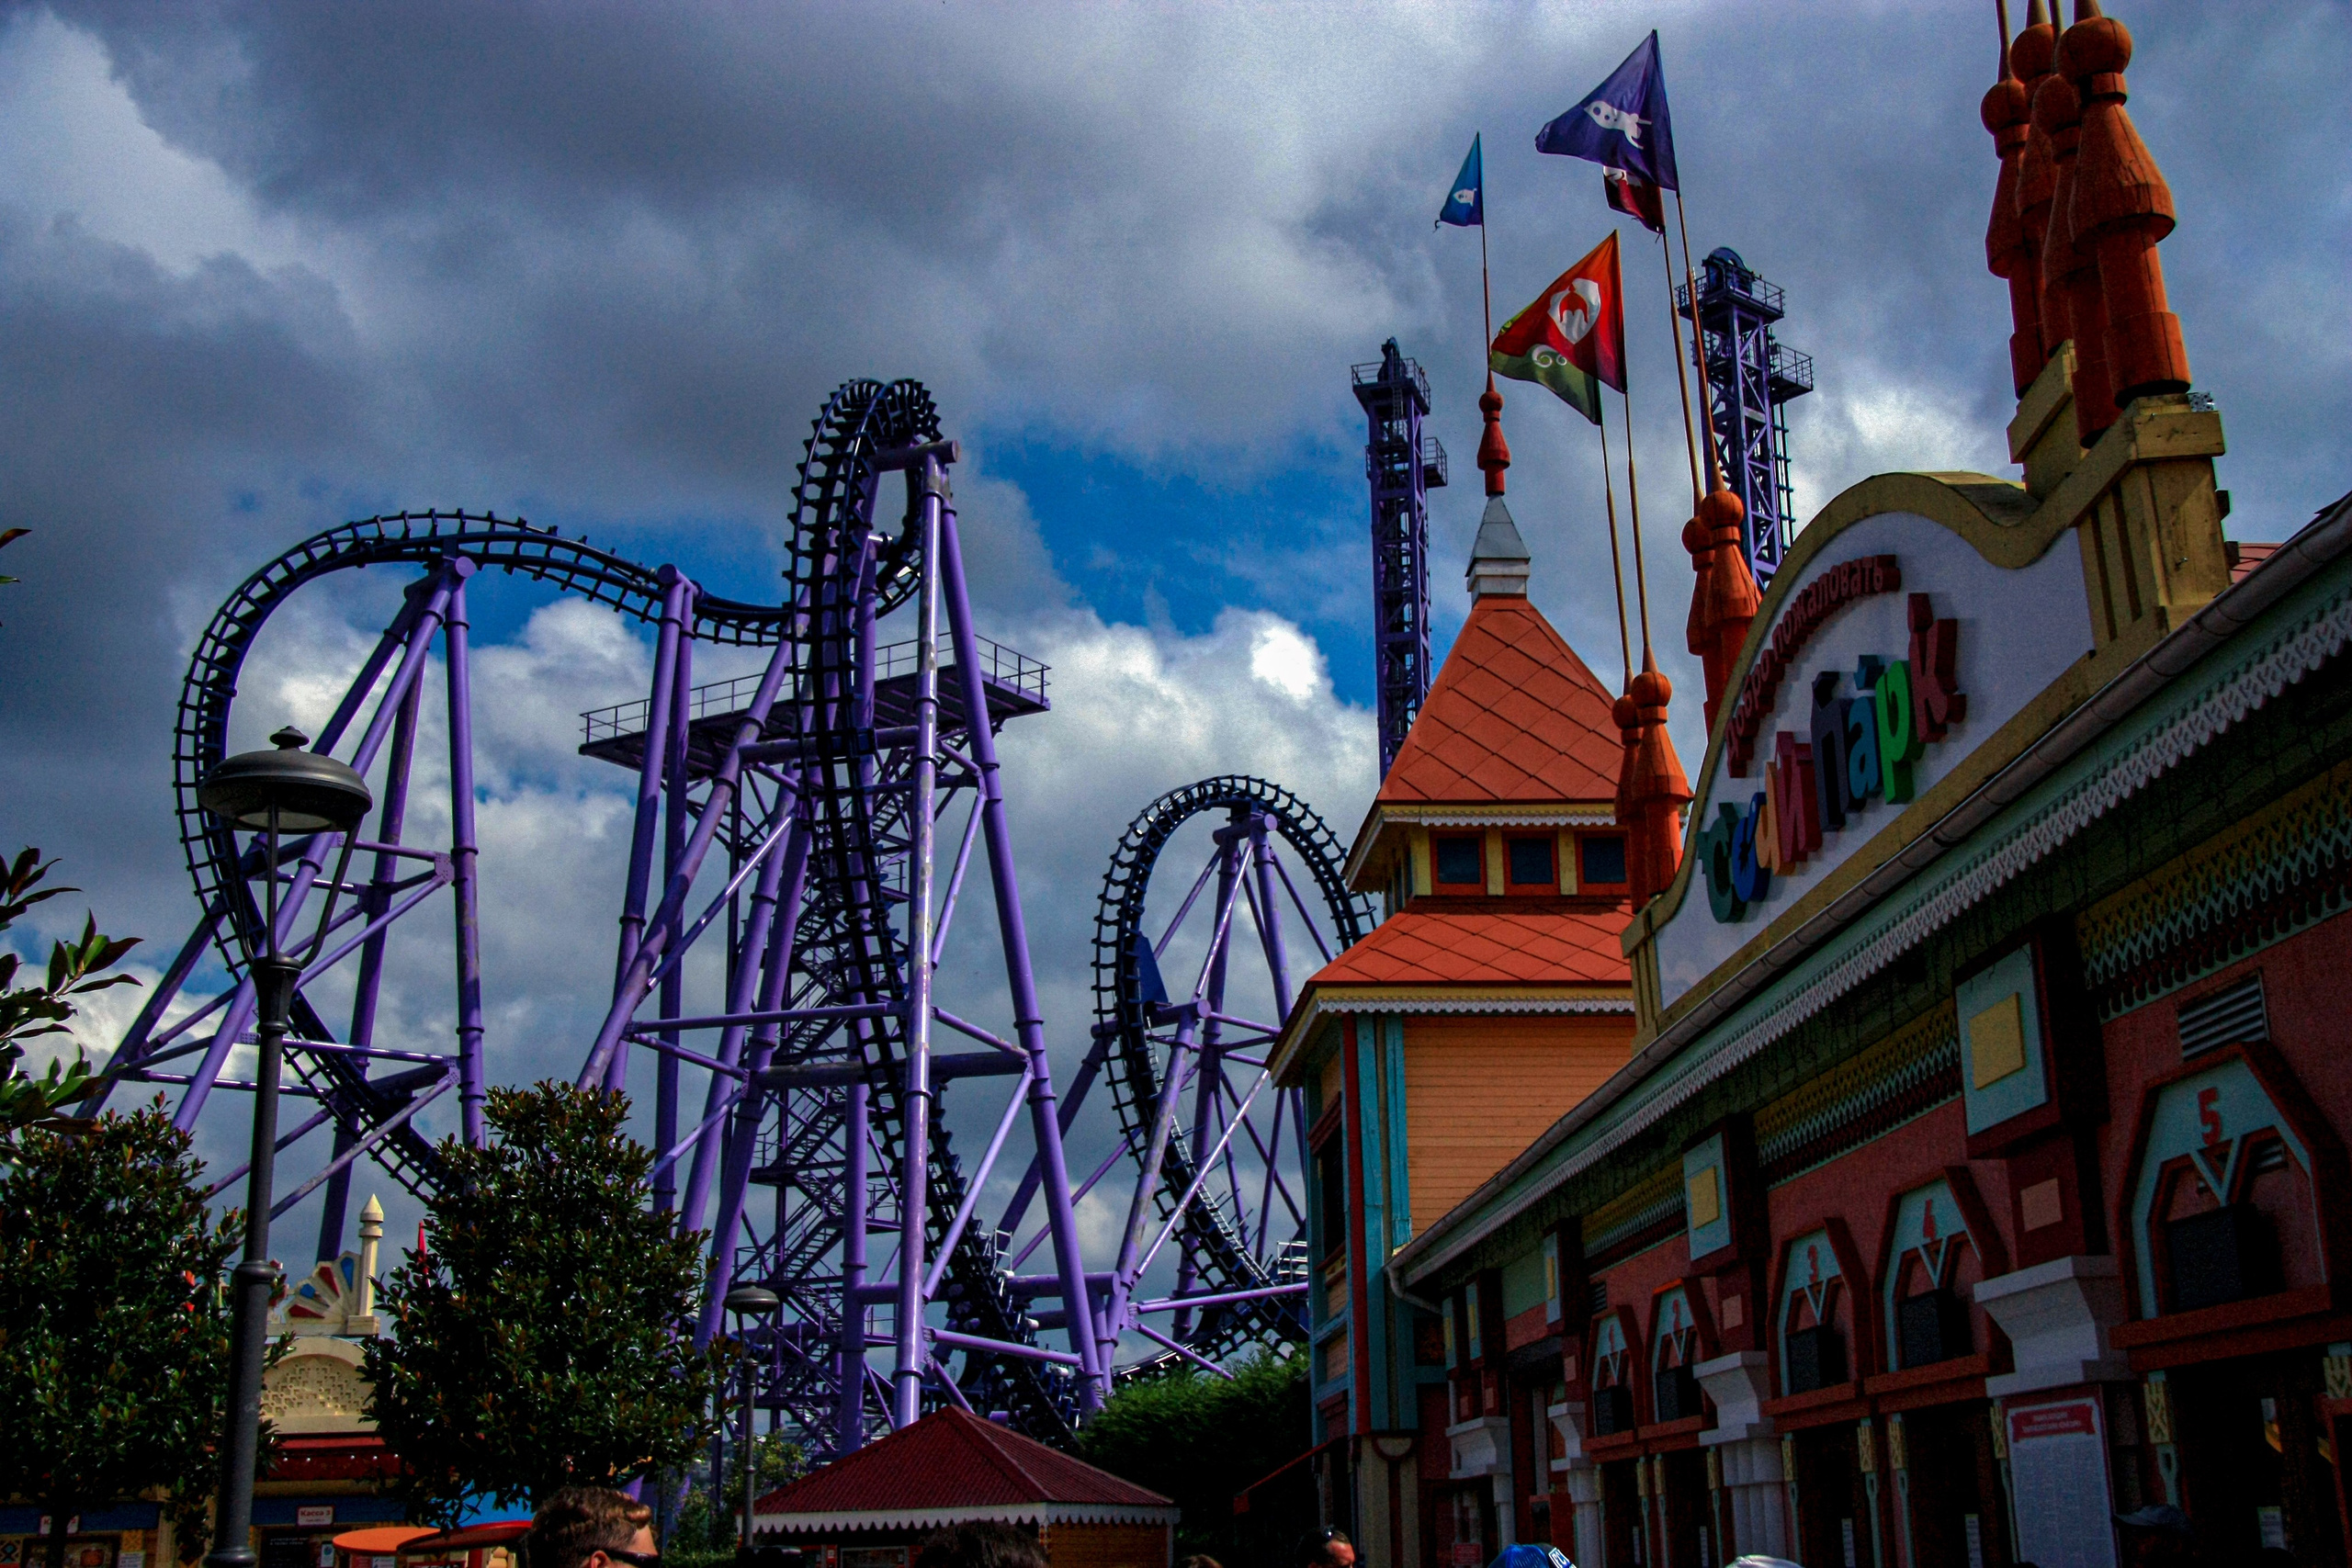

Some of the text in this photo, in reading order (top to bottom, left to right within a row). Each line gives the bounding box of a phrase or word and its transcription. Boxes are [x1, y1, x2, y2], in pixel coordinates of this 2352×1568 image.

[1772, 555, 1901, 663] пожаловать
[2198, 1088, 2222, 1145] 5
[1922, 1198, 1937, 1239] 4
[1807, 1245, 1819, 1283] 3
[1672, 1299, 1681, 1332] 2
[1609, 1324, 1616, 1353] 1
